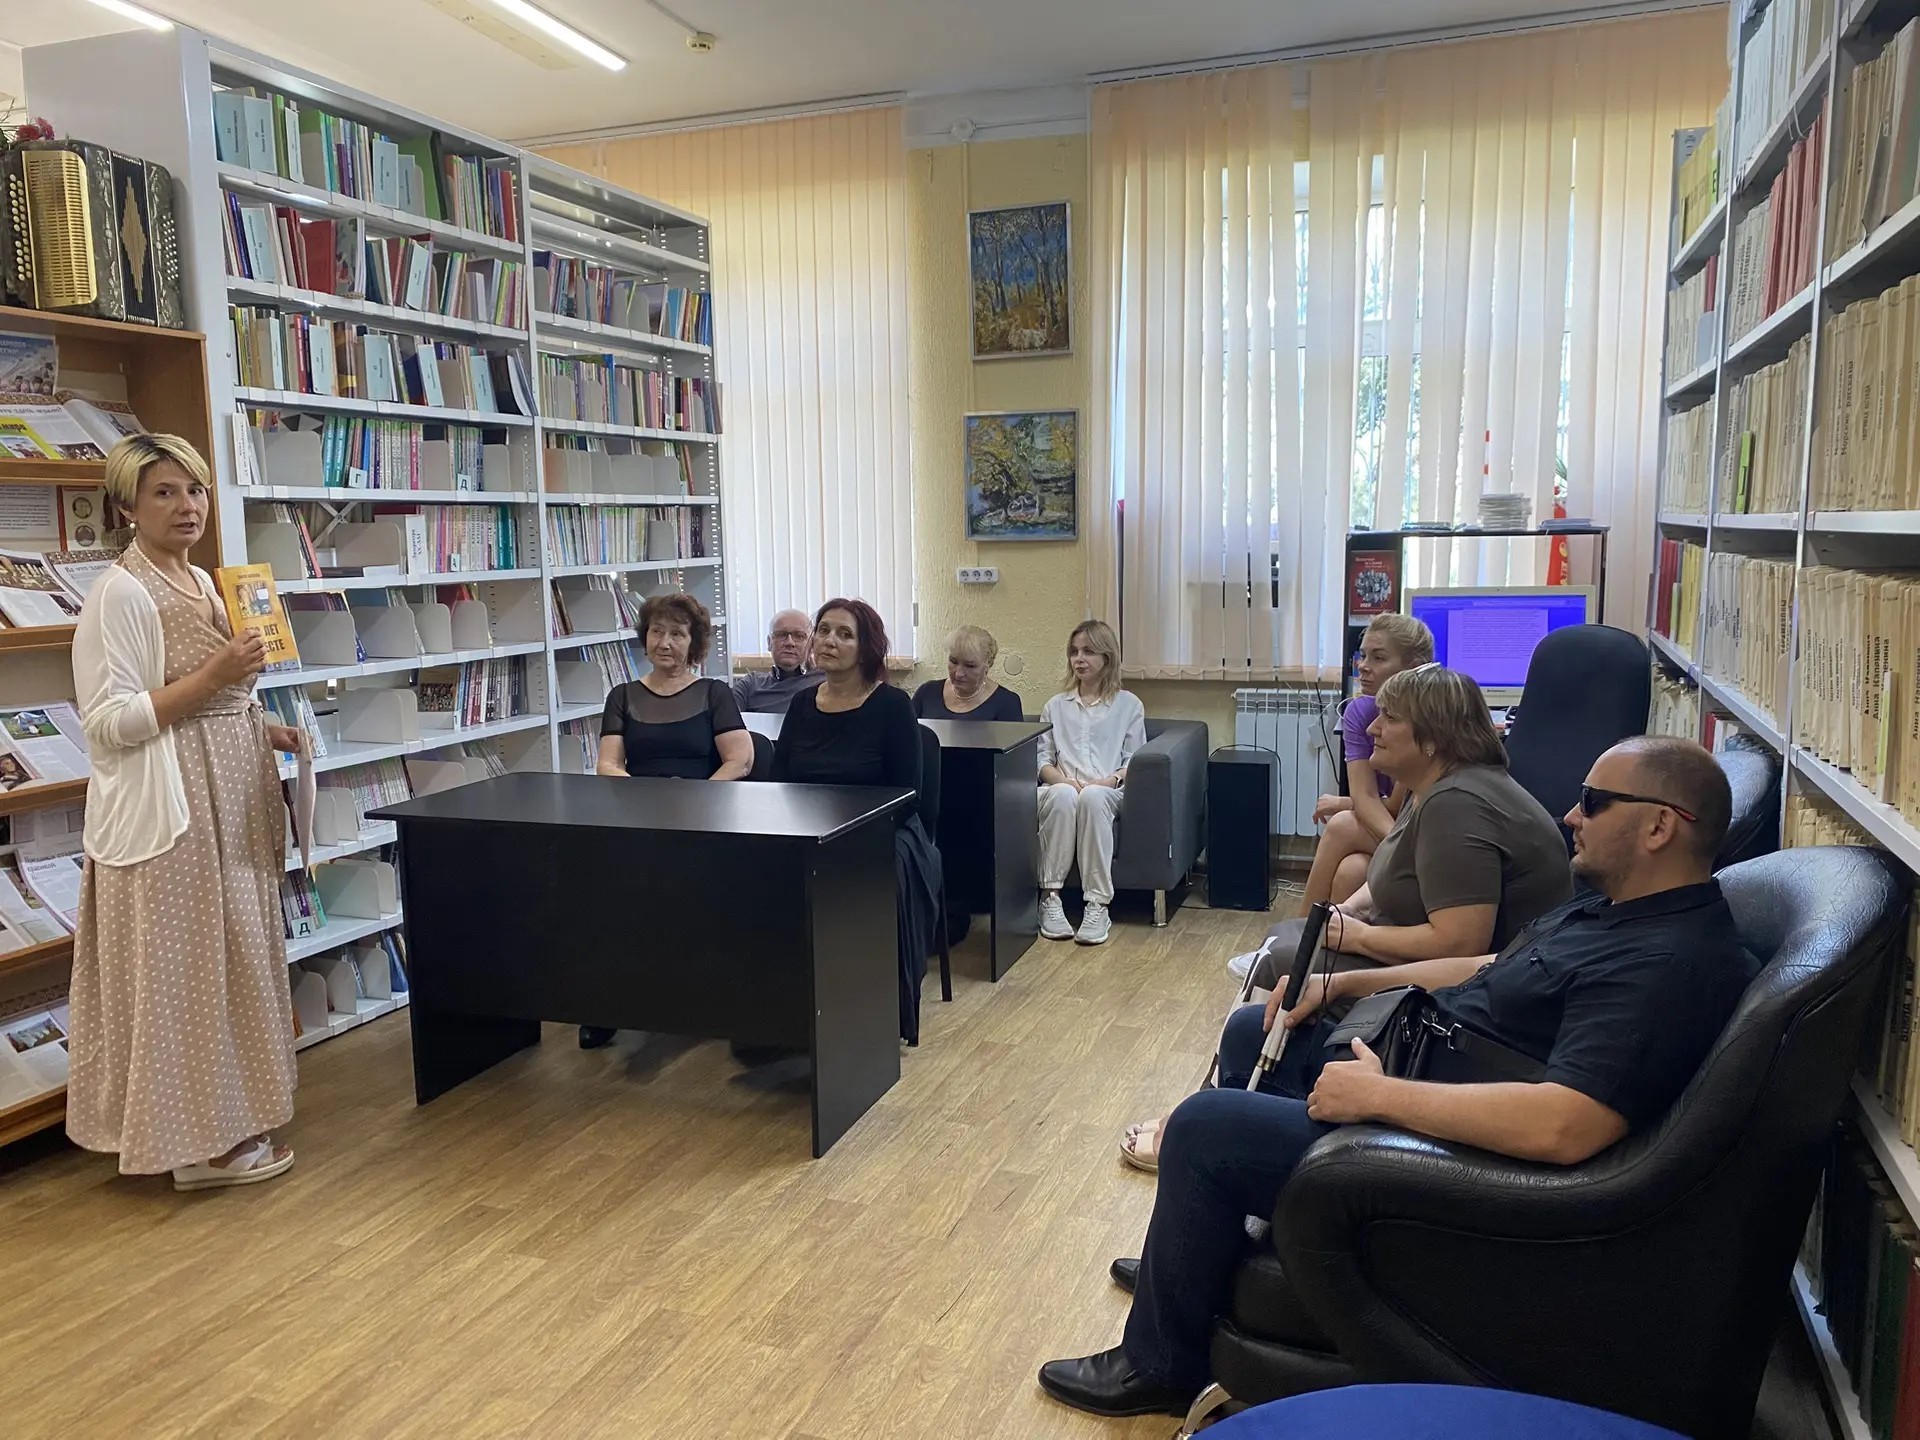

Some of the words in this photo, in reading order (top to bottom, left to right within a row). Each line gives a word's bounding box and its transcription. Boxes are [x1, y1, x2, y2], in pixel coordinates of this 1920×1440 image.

[355, 473, 362, 484] Г
[264, 624, 280, 637] ЛЕТ
[264, 639, 285, 652] ЕСТЕ
[1873, 636, 1881, 687] Каренина
[1912, 711, 1920, 740] Анна
[299, 922, 311, 936] Д
